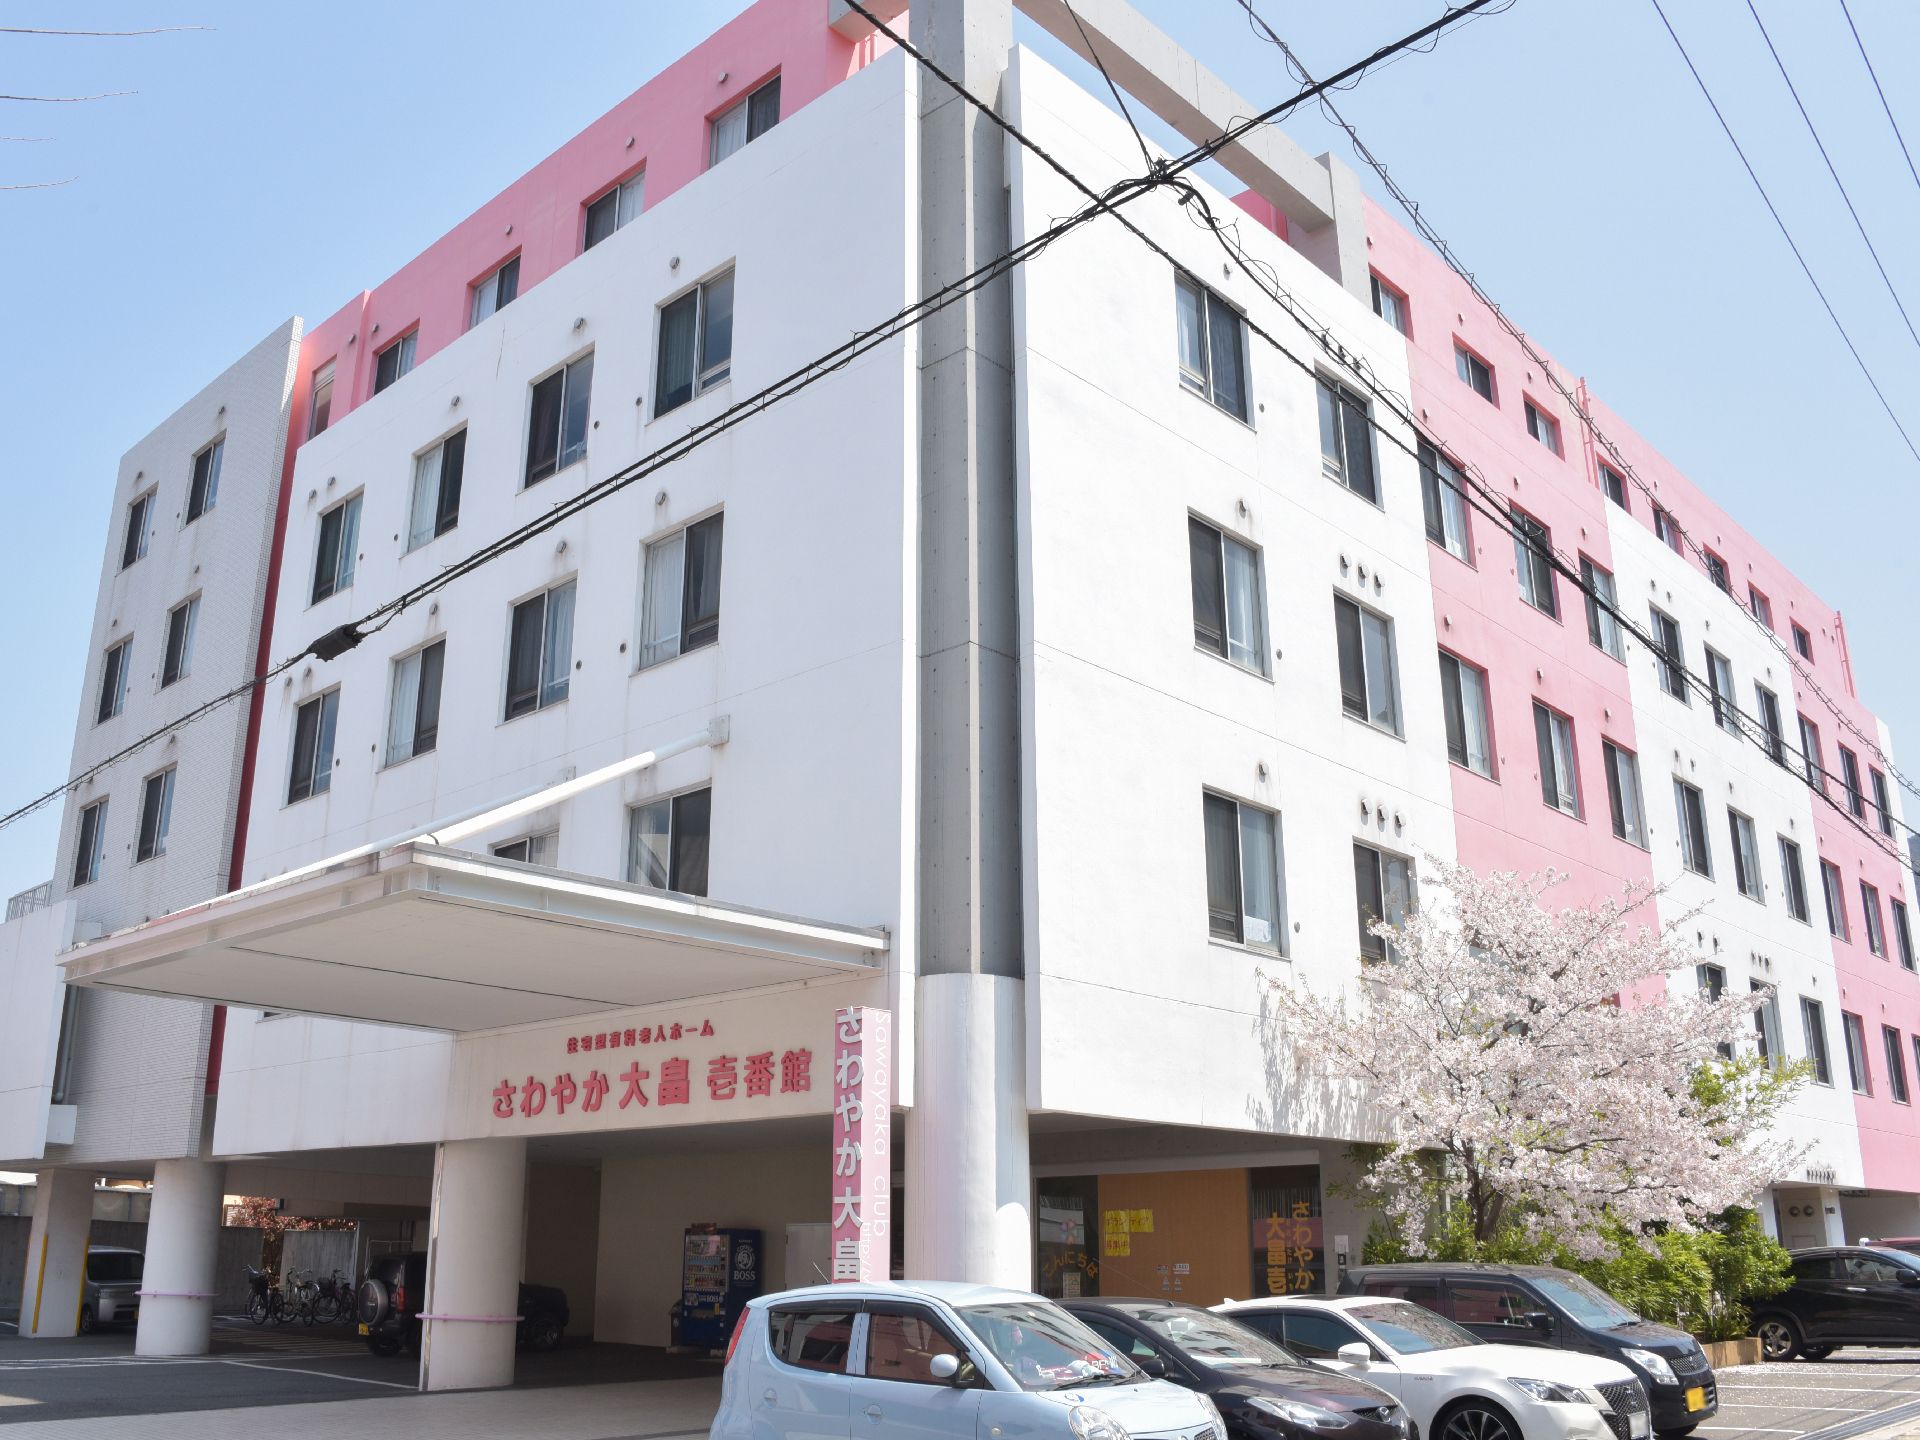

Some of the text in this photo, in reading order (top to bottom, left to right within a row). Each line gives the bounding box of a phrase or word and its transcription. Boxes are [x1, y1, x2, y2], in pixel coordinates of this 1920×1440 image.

[566, 1019, 714, 1054] 住宅型有料老人ホーム
[833, 1006, 864, 1280] さわやか大畠
[871, 1012, 890, 1237] Sawayaka club
[733, 1270, 756, 1281] BOSS
[1291, 1201, 1315, 1290] さわやか
